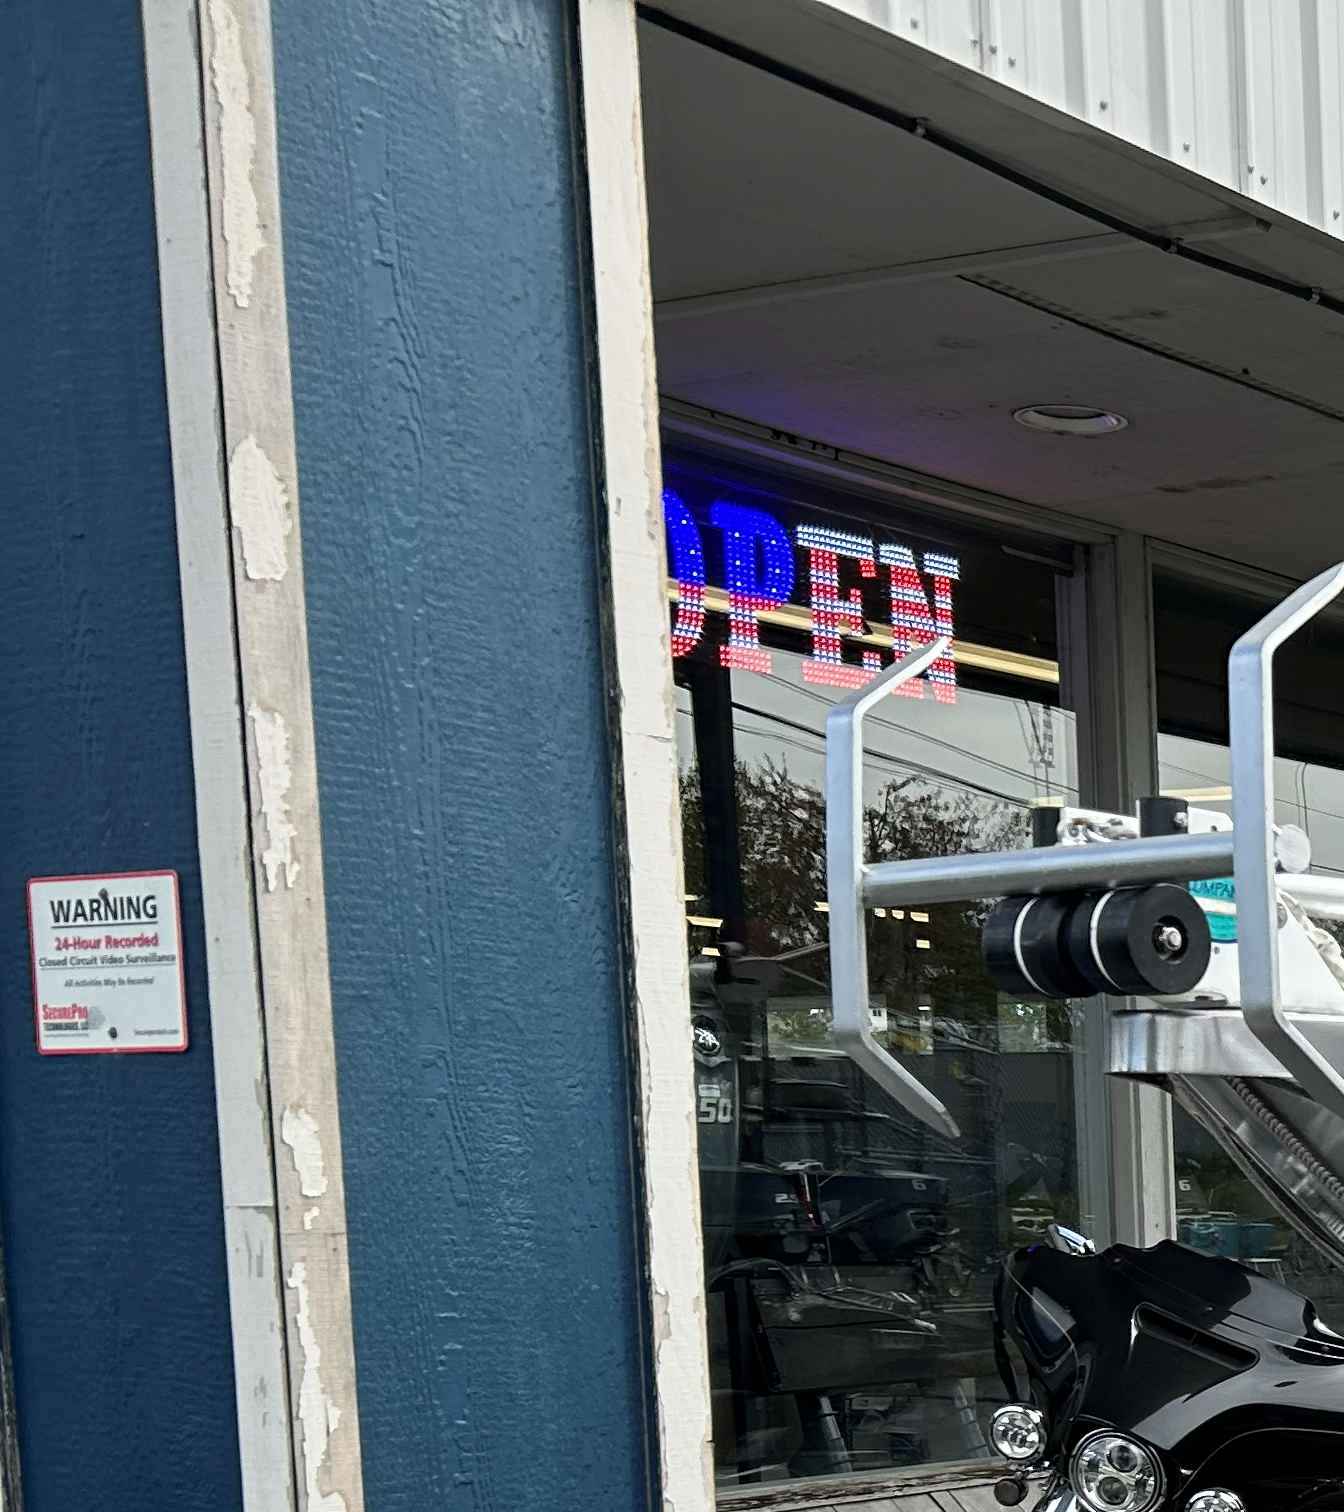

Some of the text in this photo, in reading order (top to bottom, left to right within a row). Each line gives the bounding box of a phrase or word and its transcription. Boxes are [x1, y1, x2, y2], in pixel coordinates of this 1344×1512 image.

[50, 895, 158, 923] WARNING
[54, 932, 159, 952] 24-Hour Recorded
[39, 951, 177, 967] Closed Circuit Video Surveillance
